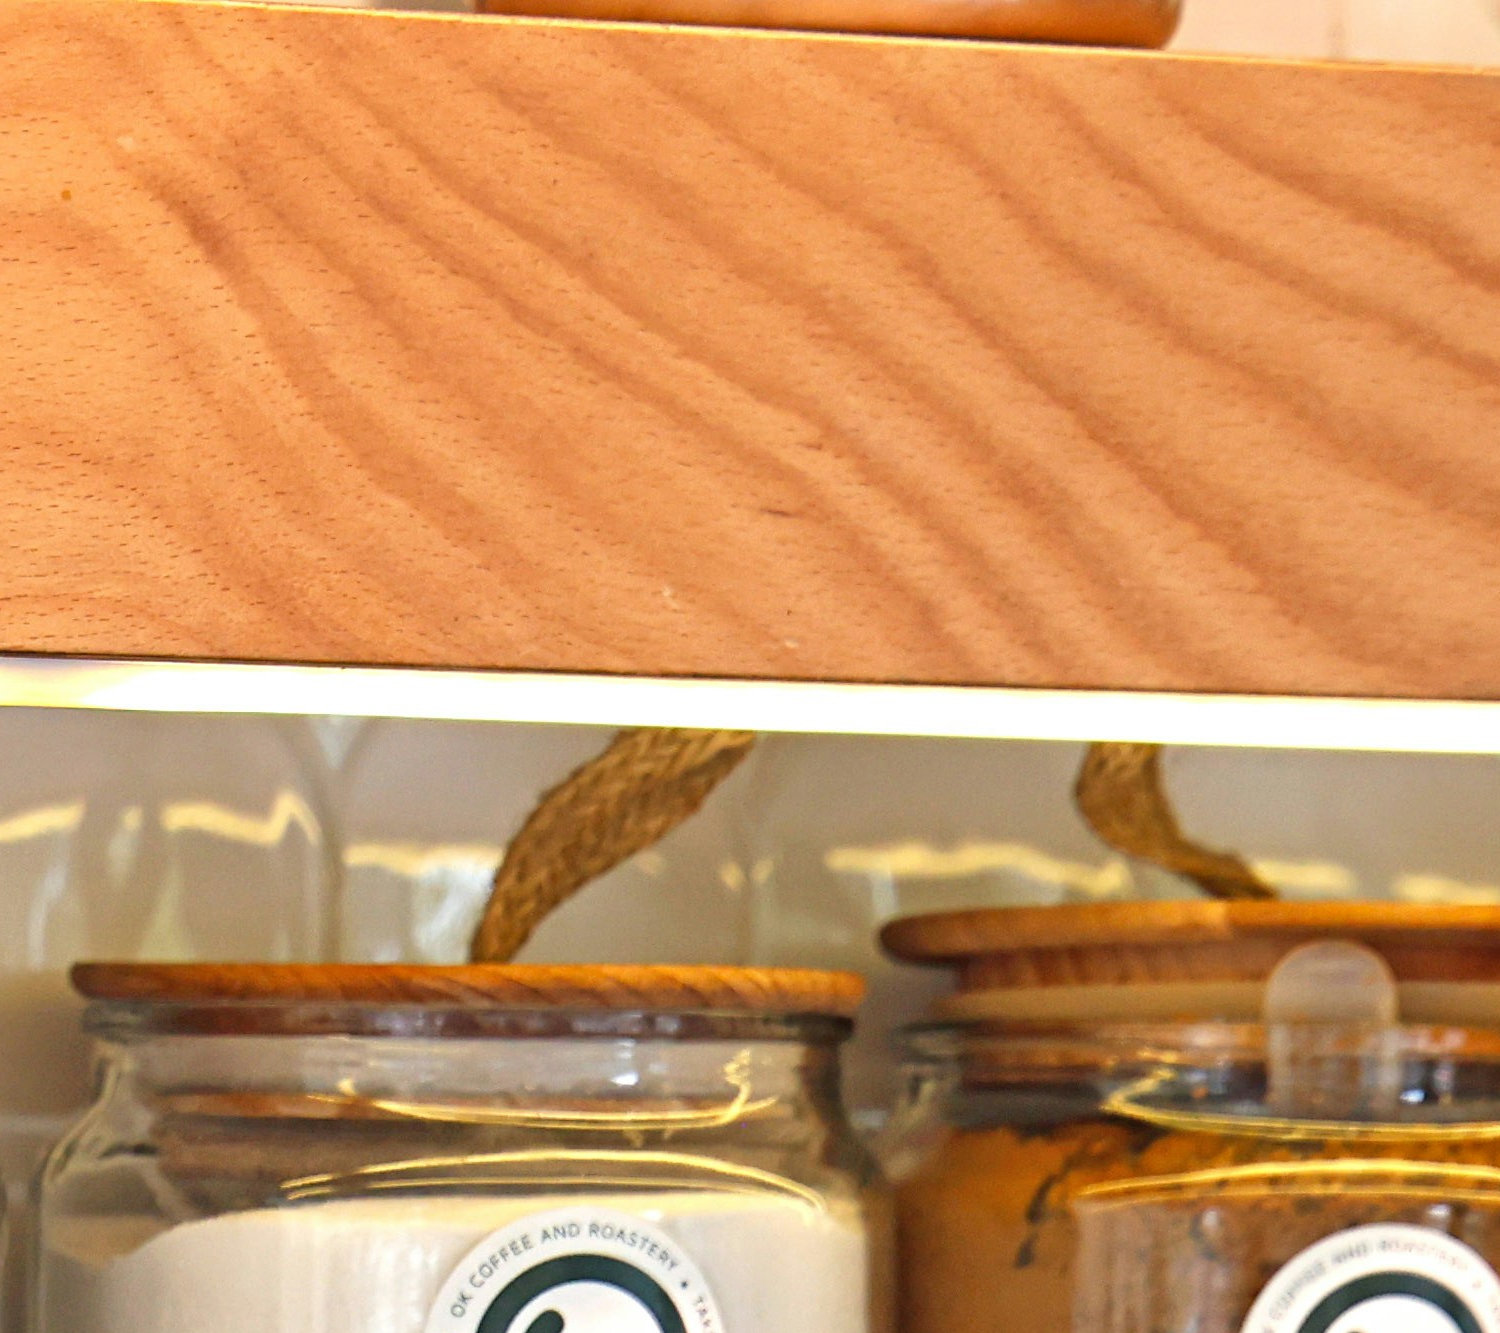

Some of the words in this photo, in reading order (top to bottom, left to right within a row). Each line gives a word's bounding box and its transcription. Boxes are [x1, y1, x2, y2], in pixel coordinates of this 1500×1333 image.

[450, 1292, 474, 1318] OK
[468, 1234, 535, 1288] COFFEE
[540, 1223, 581, 1243] AND
[588, 1222, 679, 1272] ROASTERY
